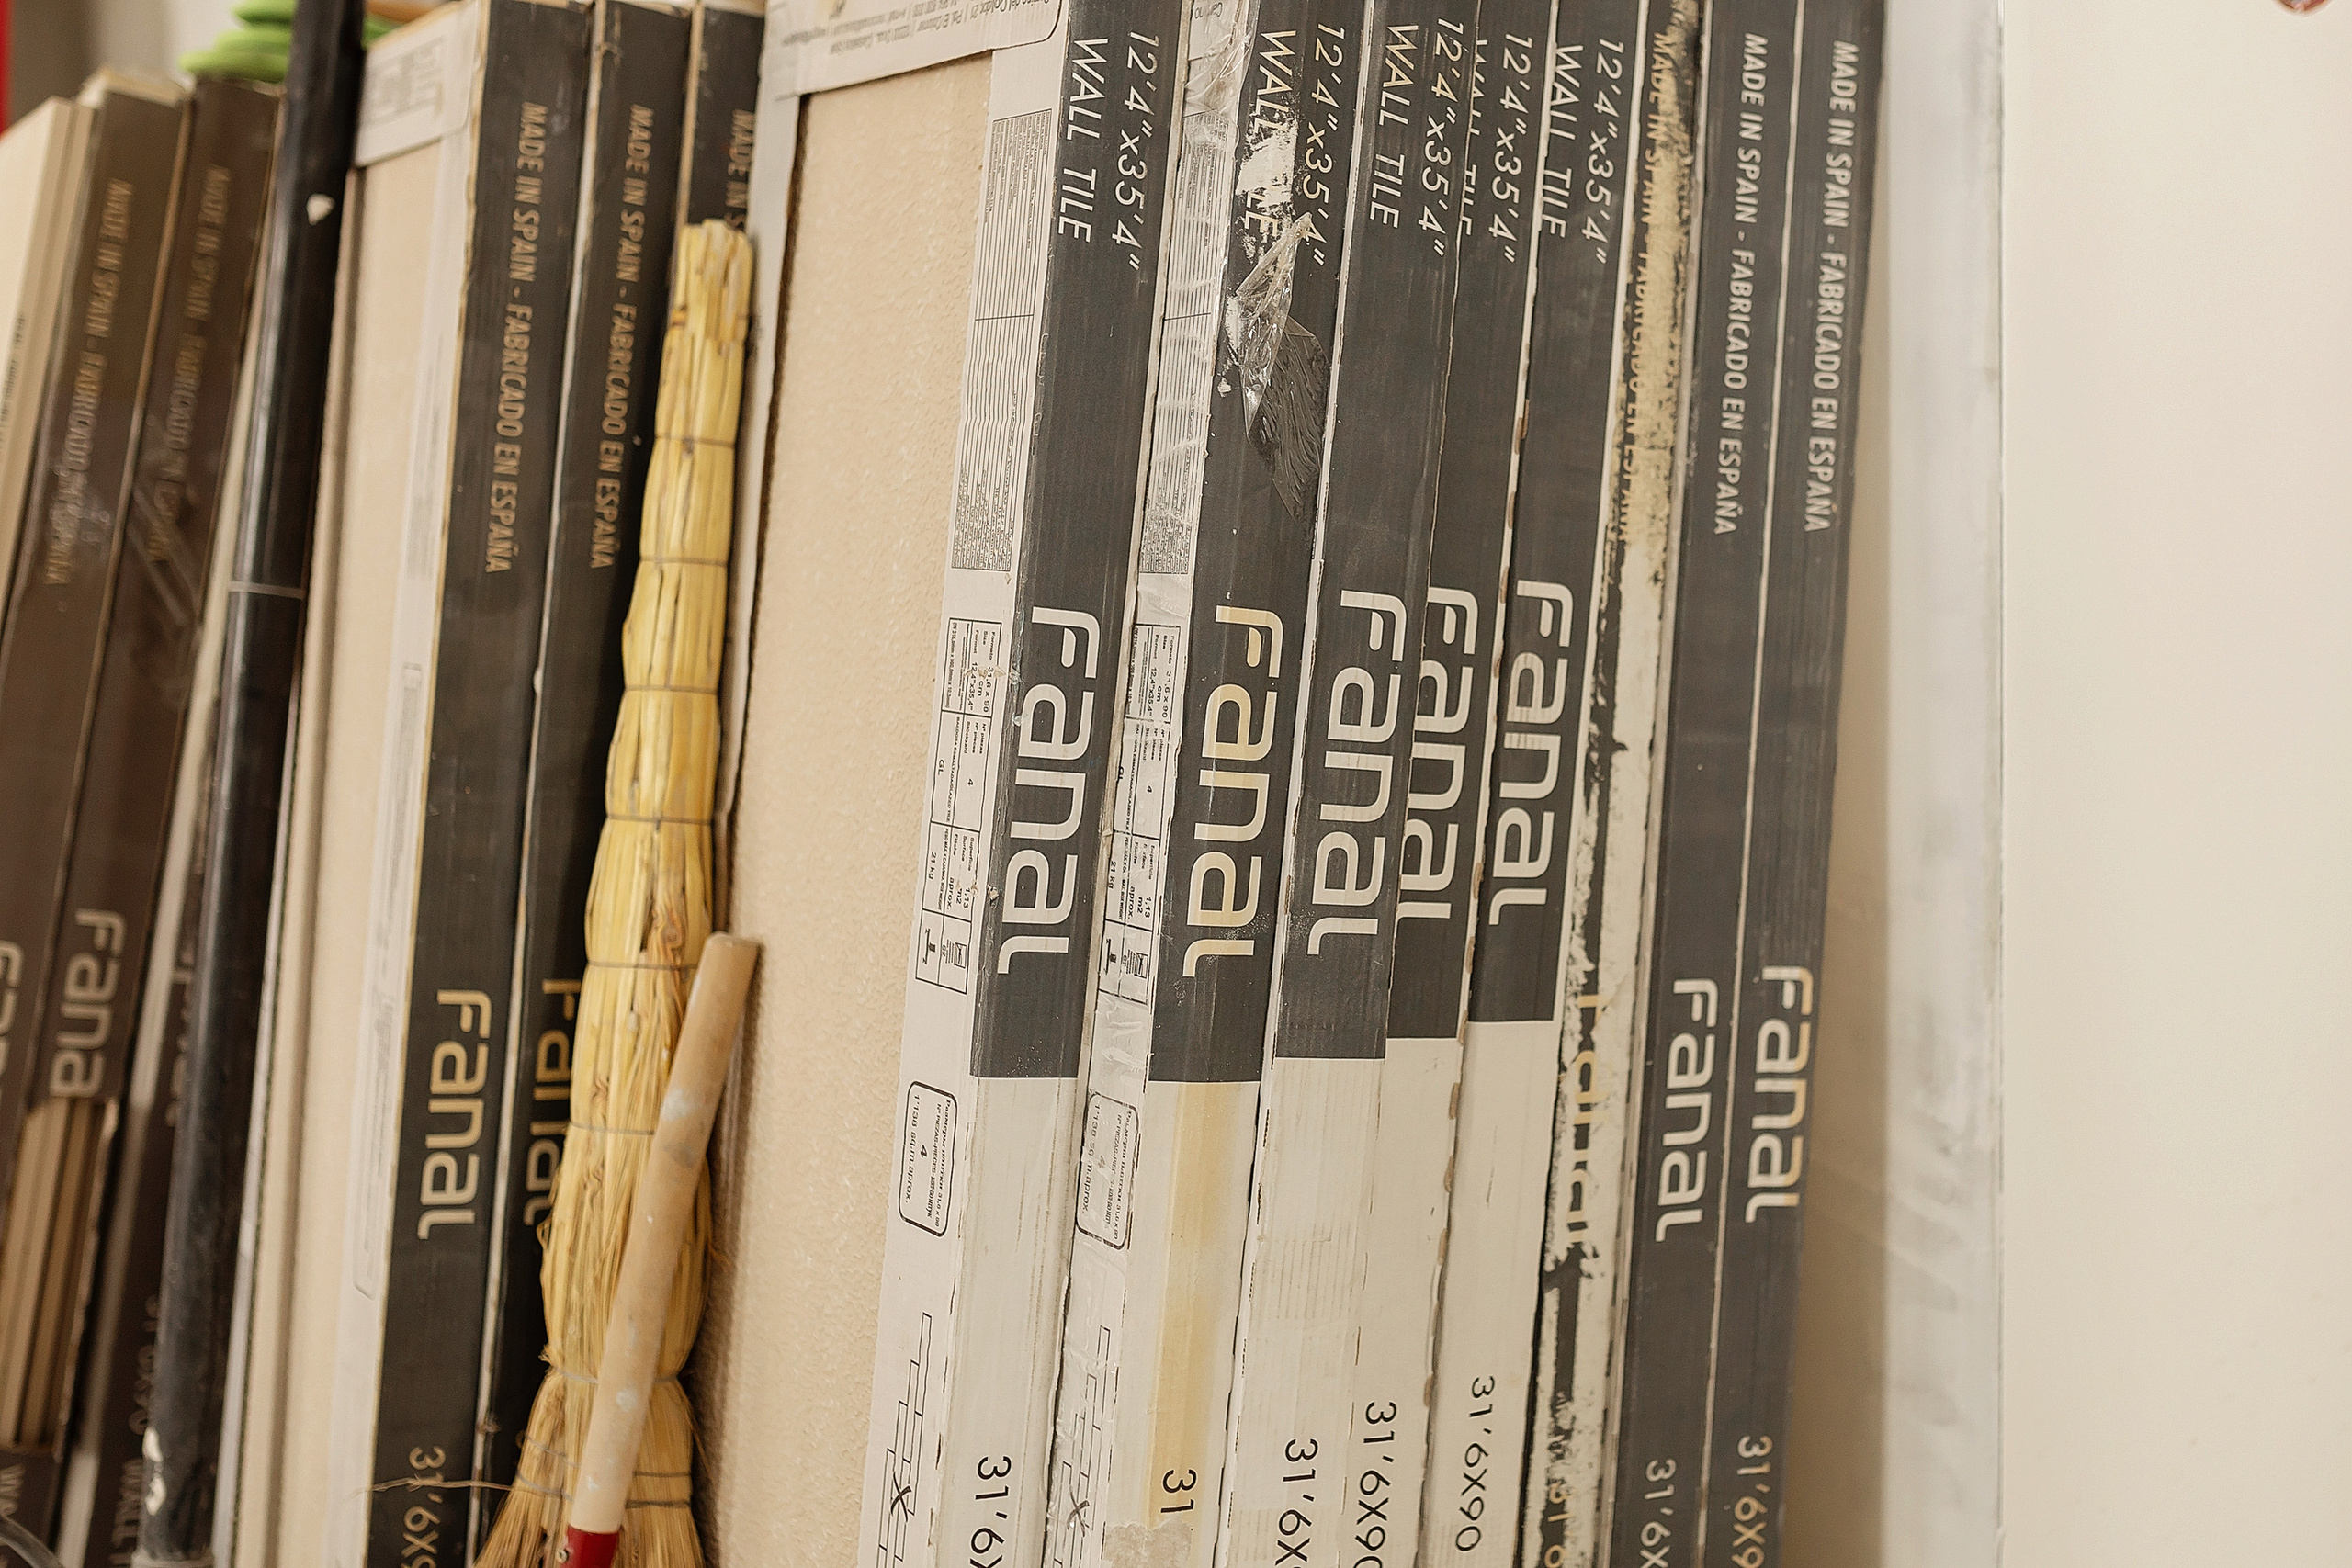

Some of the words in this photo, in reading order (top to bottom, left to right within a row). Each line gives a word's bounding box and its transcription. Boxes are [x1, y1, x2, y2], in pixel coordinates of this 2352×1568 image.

[1066, 37, 1109, 141] WALL
[1378, 23, 1419, 126] WALL
[1739, 32, 1769, 107] MADE
[1828, 39, 1860, 113] MADE
[516, 101, 548, 173] MADE
[625, 104, 655, 175] MADE
[1738, 112, 1764, 141] IN
[1827, 118, 1856, 147] IN
[514, 175, 543, 205] IN
[622, 177, 648, 207] IN
[1057, 167, 1097, 243] TILE
[1369, 152, 1405, 229] TILE
[1734, 146, 1762, 224] SPAIN
[1821, 152, 1853, 228] SPAIN
[509, 208, 540, 282] SPAIN
[616, 209, 645, 283] SPAIN
[1723, 248, 1756, 389] FABRICADO
[1813, 252, 1848, 389] FABRICADO
[496, 304, 533, 437] FABRICADO
[602, 303, 638, 435] FABRICADO
[1720, 396, 1746, 431] EN
[1810, 396, 1838, 430] EN
[493, 442, 522, 476] EN
[599, 440, 625, 473] EN
[1713, 437, 1745, 536] ESPAÑA
[1804, 435, 1837, 533] ESPAÑA
[485, 479, 520, 573] ESPAÑA
[590, 478, 621, 570] ESPAÑA
[977, 680, 984, 696] cm
[982, 700, 989, 713] 90
[1156, 685, 1162, 702] cm
[1161, 705, 1169, 718] 90
[937, 759, 944, 775] GL
[1146, 784, 1152, 793] 4
[1307, 590, 1407, 955] Fanal
[1396, 587, 1478, 920] Fanal
[1488, 579, 1573, 925] Fanal
[998, 606, 1101, 974] Fanal
[1182, 605, 1283, 977] Fanal
[928, 866, 935, 880] kg
[930, 852, 937, 863] 21
[946, 876, 955, 909] aprox.
[1110, 860, 1116, 873] 21
[962, 887, 970, 908] 1,13
[1136, 897, 1143, 913] m2
[49, 908, 126, 1099] Fana
[417, 989, 492, 1240] Fanal
[1656, 978, 1718, 1242] Fanal
[1746, 966, 1814, 1223] Fanal
[920, 1144, 927, 1157] 4
[1160, 1468, 1197, 1514] 31
[1455, 1375, 1496, 1551] 31'6X90
[1274, 1438, 1320, 1568] 31'6X
